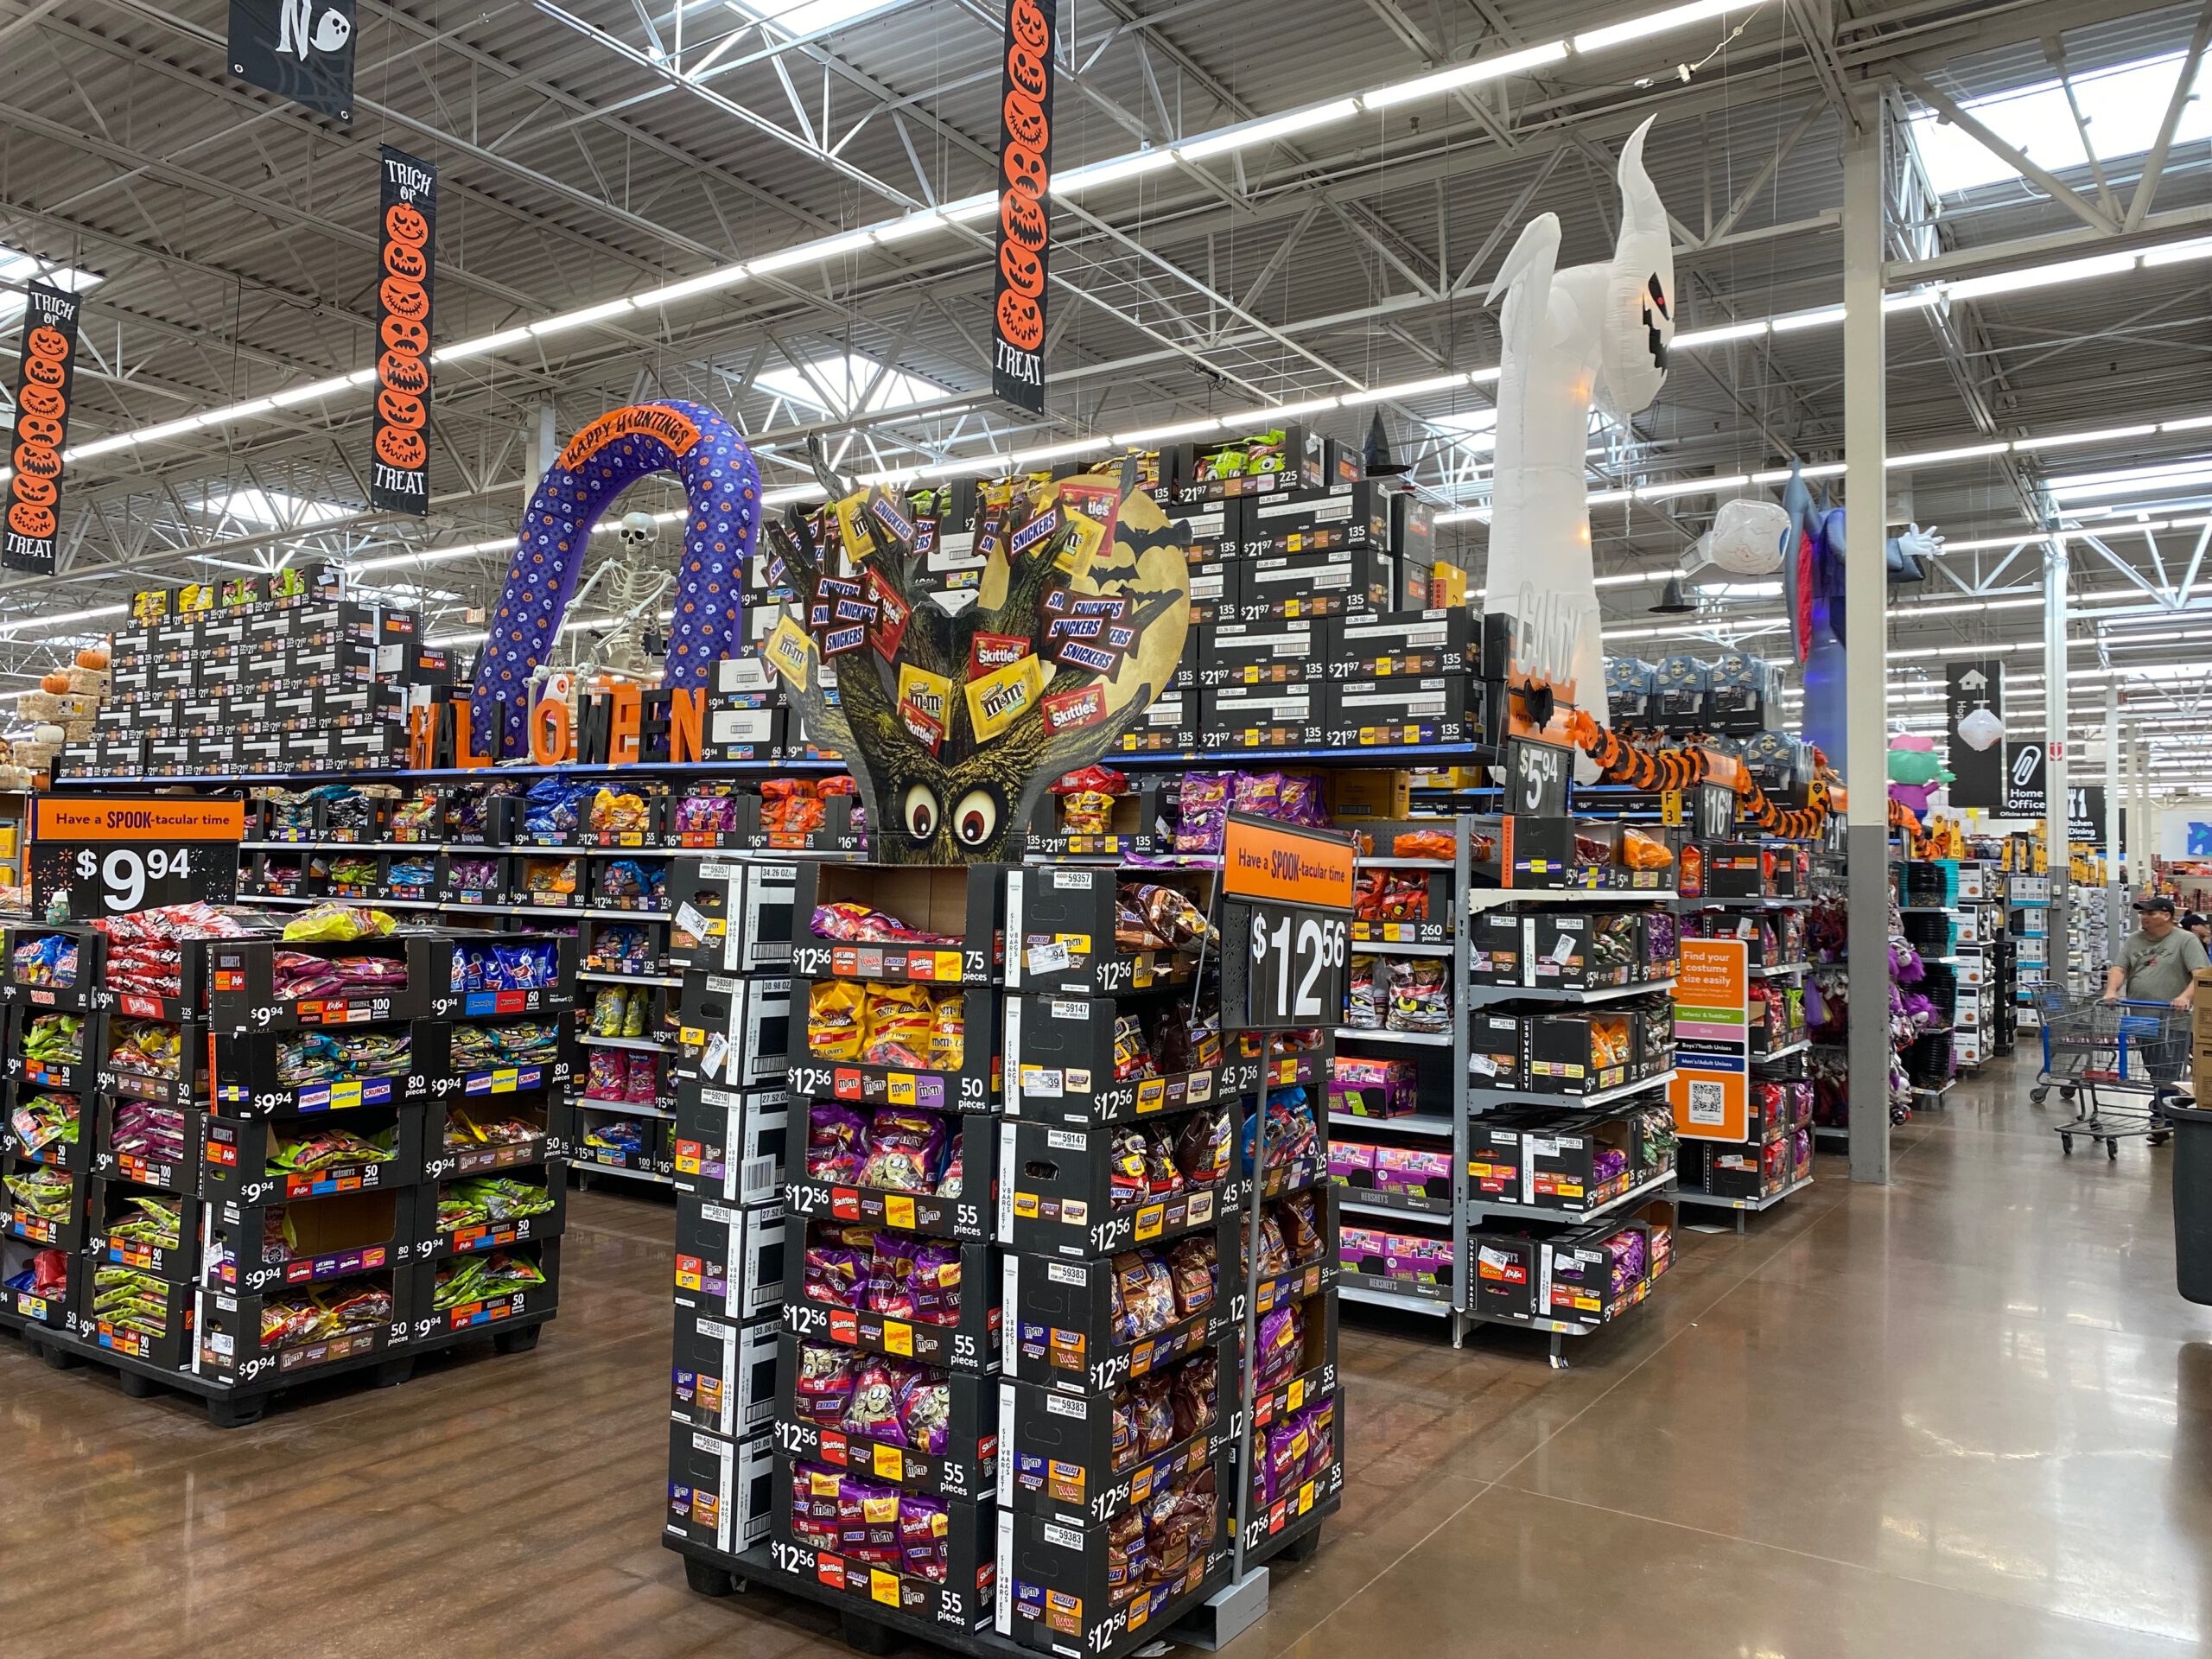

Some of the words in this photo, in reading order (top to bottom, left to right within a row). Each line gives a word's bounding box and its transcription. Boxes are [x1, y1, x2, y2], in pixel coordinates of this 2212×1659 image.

[385, 159, 432, 195] TRICK
[30, 291, 75, 320] TRICK
[996, 338, 1043, 386] TREAT
[567, 421, 611, 465] HAPPY
[374, 463, 425, 496] TREAT
[1280, 471, 1298, 482] 225
[1154, 488, 1169, 498] 135
[874, 499, 912, 540] SNICKERS
[1013, 510, 1056, 551] SNICKERS
[1348, 525, 1365, 537] 135
[7, 531, 54, 560] TREAT
[1220, 542, 1236, 553] 135
[1347, 594, 1364, 606] 135
[1219, 604, 1235, 616] 135
[827, 626, 863, 651] SNICKERS
[979, 649, 1020, 664] Skittles
[1063, 643, 1115, 671] SNICKERS
[1443, 653, 1461, 664] 135
[1306, 664, 1323, 674] 135
[1178, 671, 1193, 682] 135
[1053, 702, 1097, 727] Skittles
[1305, 728, 1321, 738] 135
[1441, 723, 1459, 734] 135
[2010, 788, 2044, 798] Home
[2008, 799, 2046, 809] Office
[56, 813, 90, 824] Have
[94, 815, 102, 825] a
[107, 810, 198, 829] SPOOK-tacular
[202, 814, 229, 825] time
[1667, 810, 1674, 822] 3
[1135, 836, 1151, 846] 135
[1239, 848, 1261, 870] Have
[1264, 860, 1268, 870] a
[1271, 849, 1327, 882] SPOOK-tacular
[1329, 867, 1345, 883] time
[1421, 924, 1442, 936] 260
[885, 957, 907, 966] SNICKERS
[910, 958, 933, 968] Skittles
[965, 950, 984, 969] 75
[1683, 951, 1705, 963] Find
[1707, 953, 1730, 966] your
[1686, 963, 1728, 974] costume
[963, 971, 988, 982] pieces
[1683, 974, 1702, 984] size
[1705, 975, 1732, 988] easily
[527, 991, 539, 1002] 60
[550, 995, 569, 1004] Walmart
[372, 999, 390, 1010] 100
[555, 1063, 569, 1075] 80
[1222, 1066, 1236, 1084] 45
[408, 1075, 425, 1089] 80
[519, 1071, 541, 1083] CRUNCH
[552, 1074, 570, 1084] pieces
[179, 1084, 189, 1097] 50
[364, 1085, 390, 1098] CRUNCH
[405, 1087, 427, 1096] pieces
[961, 1077, 983, 1097] 50
[1219, 1085, 1236, 1096] pieces
[958, 1098, 986, 1110] pieces
[547, 1137, 559, 1150] 50
[1316, 1152, 1327, 1169] 125
[365, 1165, 378, 1177] 50
[1223, 1183, 1237, 1202] 45
[1361, 1192, 1389, 1205] HERSHEY'S
[833, 1196, 857, 1207] Skittles
[957, 1204, 977, 1225] 55
[1221, 1203, 1239, 1217] pieces
[518, 1219, 530, 1230] 50
[954, 1224, 982, 1236] pieces
[1370, 1278, 1397, 1292] HERSHEY'S
[391, 1321, 408, 1336] 50
[832, 1319, 855, 1330] Skittles
[388, 1335, 409, 1346] pieces
[955, 1334, 975, 1356] 55
[950, 1353, 978, 1368] pieces
[1323, 1363, 1334, 1382] 55
[822, 1440, 846, 1452] Skittles
[944, 1460, 964, 1484] 55
[1332, 1462, 1341, 1481] 55
[940, 1480, 968, 1497] pieces
[942, 1589, 962, 1612] 55
[938, 1610, 965, 1625] pieces
